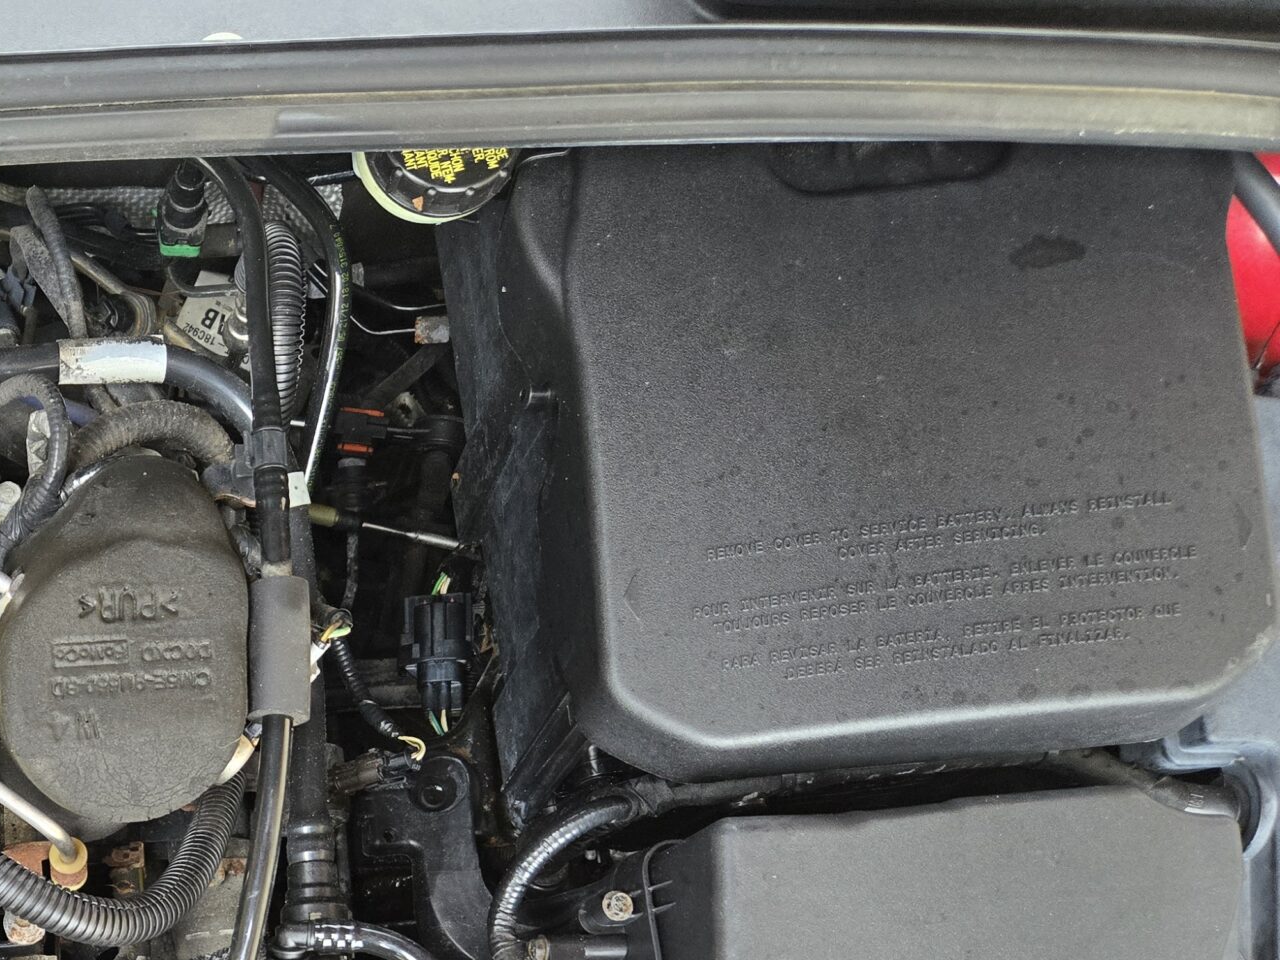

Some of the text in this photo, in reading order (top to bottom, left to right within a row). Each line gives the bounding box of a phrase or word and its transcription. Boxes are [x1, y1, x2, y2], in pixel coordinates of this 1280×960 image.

[425, 149, 442, 180] IQUIDE
[483, 148, 499, 170] ROM
[495, 147, 509, 161] SE
[707, 541, 764, 562] REMOVE
[773, 532, 821, 551] COVER
[830, 528, 850, 544] TO
[860, 517, 928, 540] SERVICE
[1022, 498, 1079, 519] ALWAYS
[1088, 490, 1172, 513] REINSTALL
[838, 542, 886, 560] COVER
[895, 535, 944, 553] AFTER
[692, 602, 730, 619] POUR
[740, 586, 837, 612] INTERVENIR
[847, 581, 876, 597] SUR
[885, 577, 905, 592] LA
[1011, 556, 1075, 578] ENLEVER
[1082, 554, 1104, 569] LE
[1115, 545, 1199, 567] COUVERCLE
[713, 612, 790, 634] TOUJOURS
[800, 601, 868, 622] REPOSER
[878, 597, 897, 611] LE
[907, 585, 993, 609] COUVERCLE
[721, 655, 761, 672] PARA
[770, 642, 838, 665] REVISAR
[847, 638, 868, 653] LA
[962, 618, 1021, 639] RETIRE
[1031, 615, 1050, 631] EL
[1059, 607, 1146, 629] PROTECTOR
[1153, 602, 1182, 618] QUE
[854, 655, 884, 671] SER
[893, 641, 998, 667] REINSTALADO
[1009, 637, 1028, 652] AL
